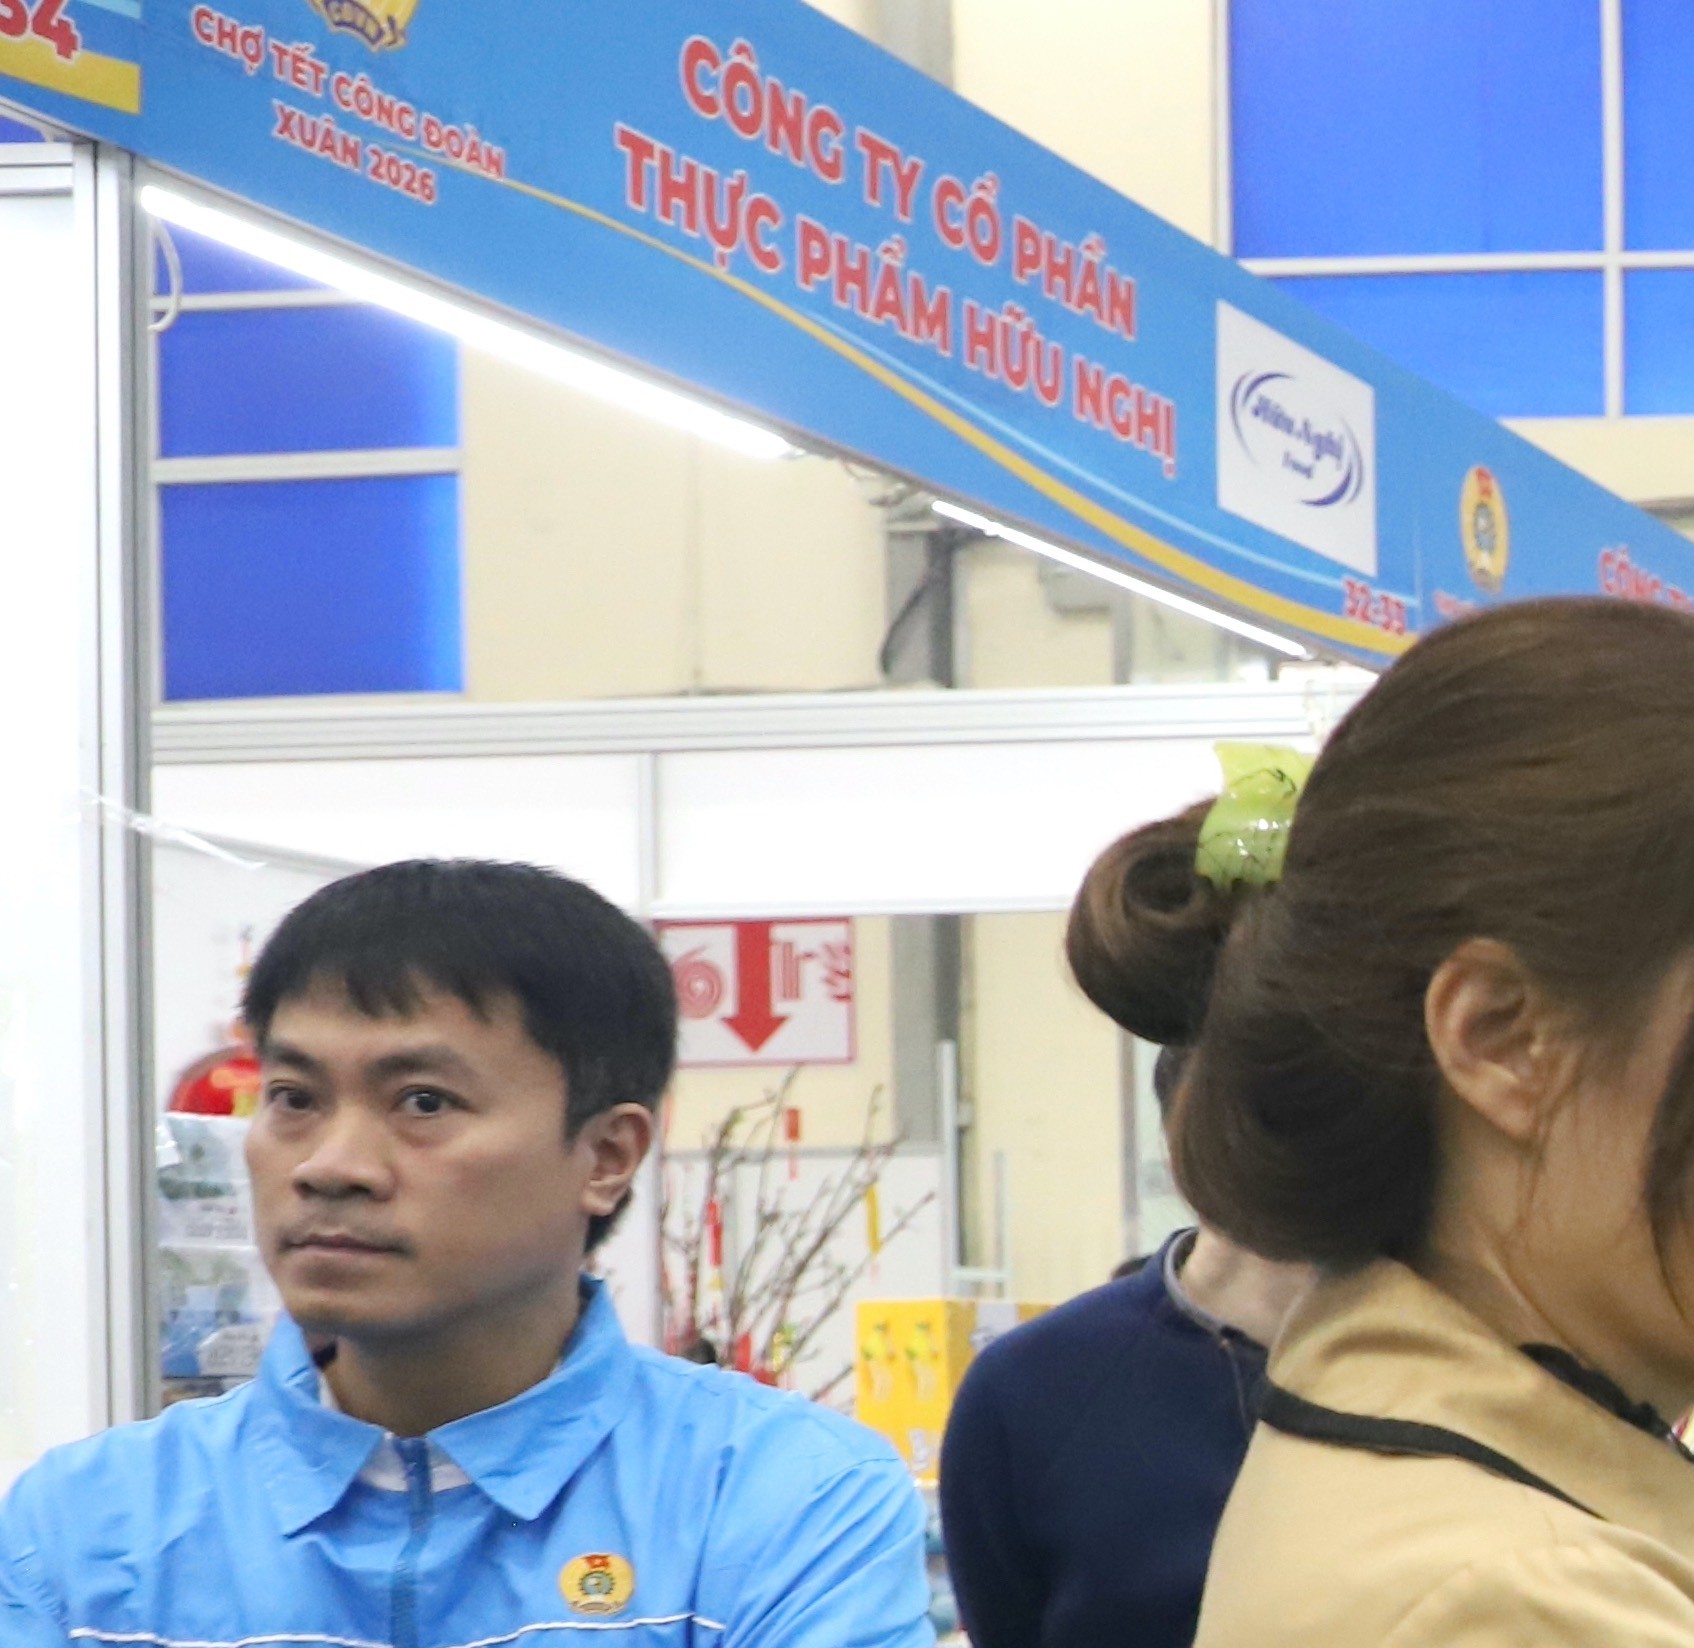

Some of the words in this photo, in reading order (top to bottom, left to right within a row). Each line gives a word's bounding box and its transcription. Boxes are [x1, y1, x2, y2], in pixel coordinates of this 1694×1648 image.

[192, 5, 264, 75] CHỢ
[271, 38, 327, 96] TẾT
[332, 72, 416, 139] CÔNG
[422, 112, 505, 180] ĐOÀN
[272, 100, 362, 172] XUÂN
[367, 146, 437, 204] 2026
[682, 36, 843, 183] CÔNG
[856, 127, 924, 223] TY
[933, 172, 999, 265] CỔ
[1013, 215, 1136, 340] PHẦN
[614, 122, 783, 275] THỰC
[798, 213, 951, 357] PHẨM
[964, 300, 1062, 406] HỮU
[1073, 356, 1175, 477] NGHỊ
